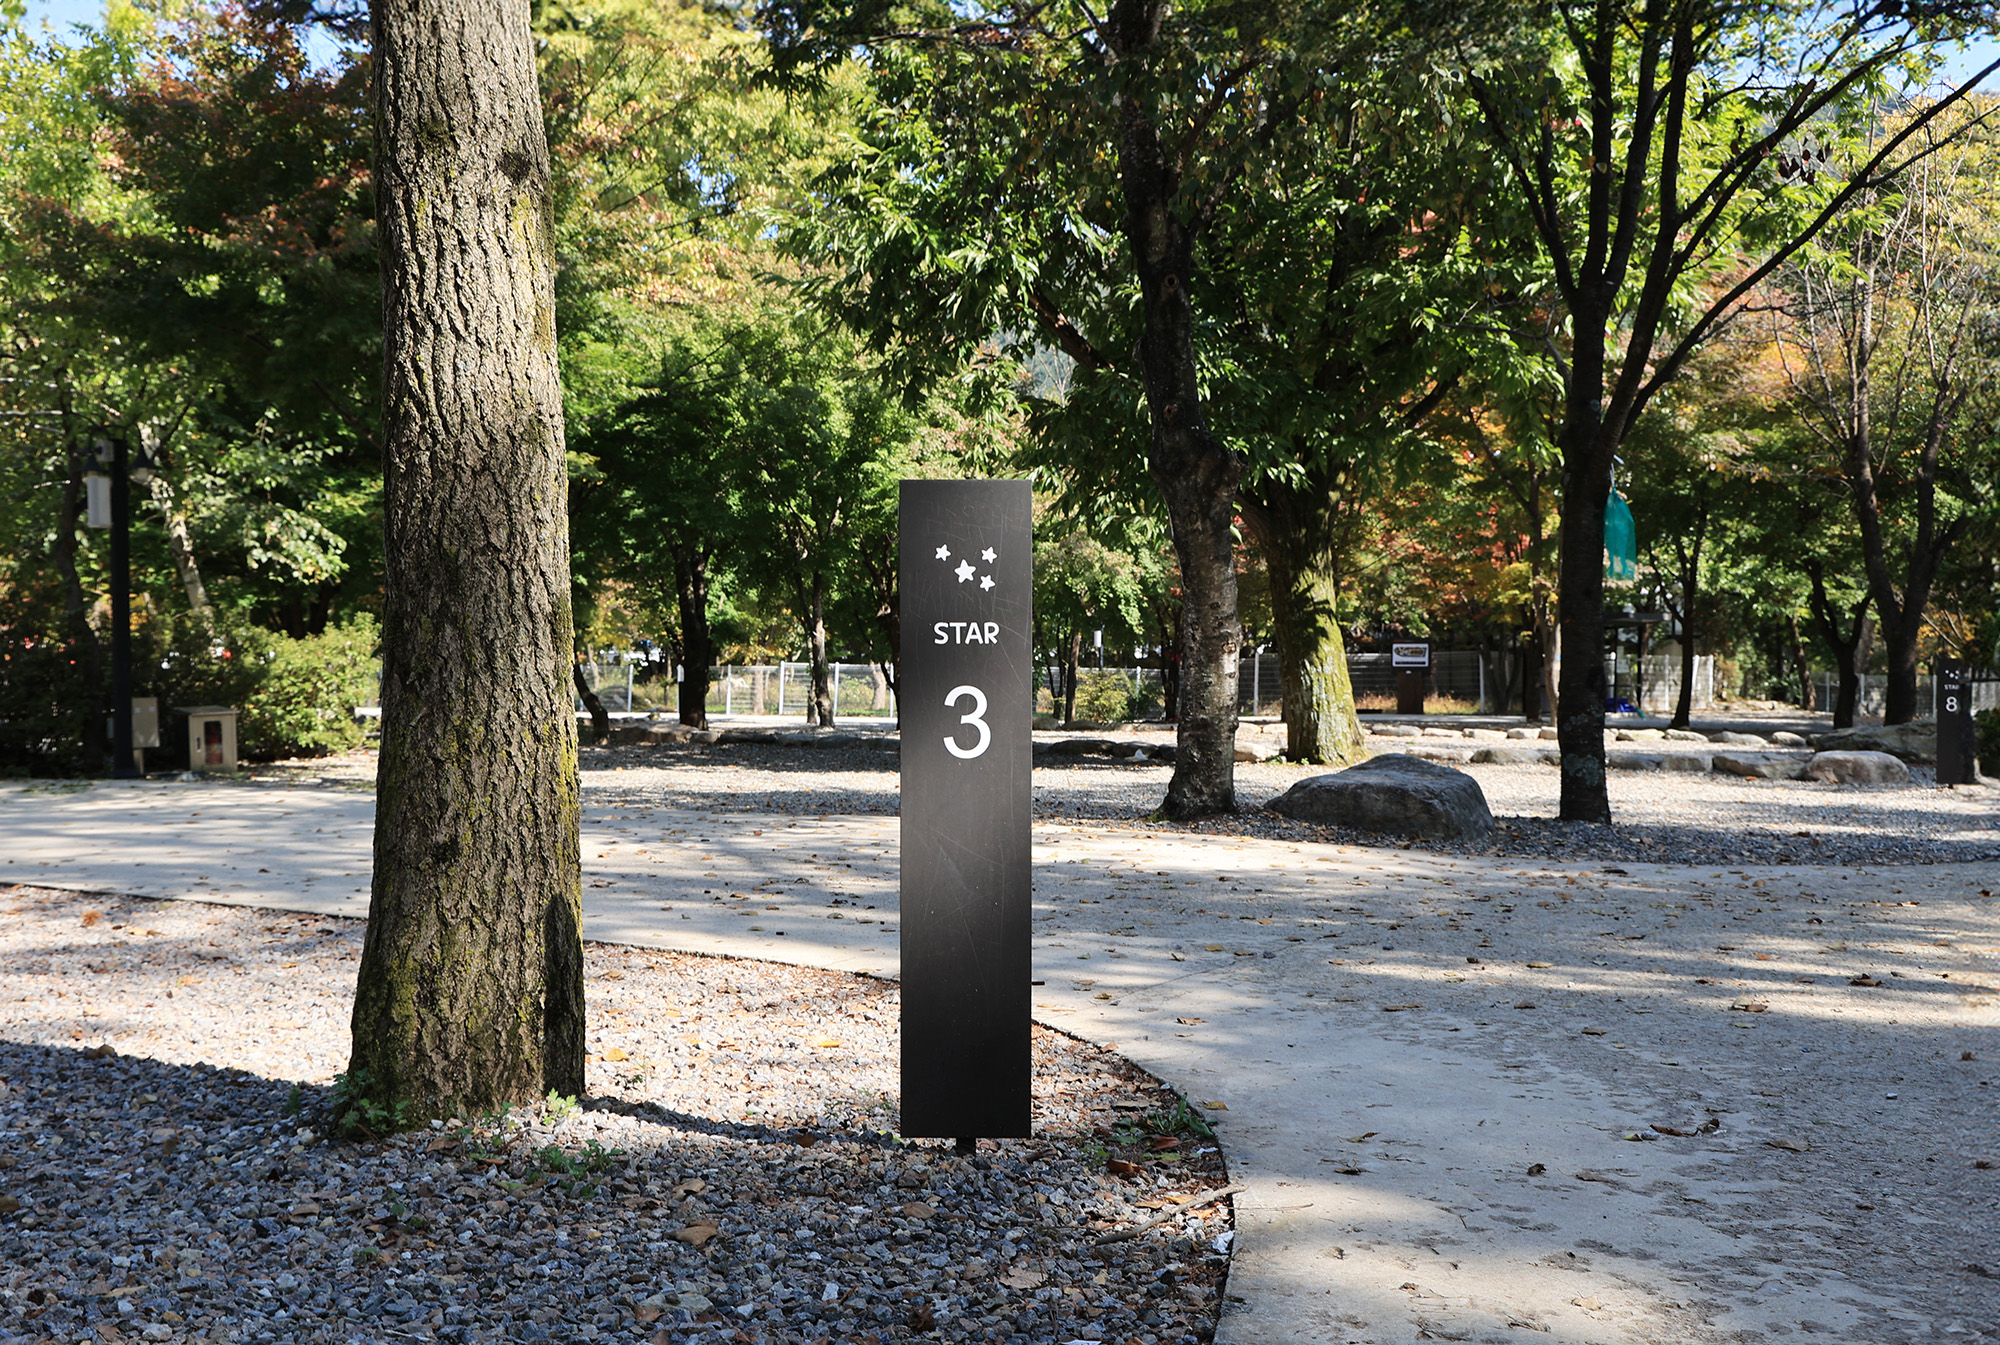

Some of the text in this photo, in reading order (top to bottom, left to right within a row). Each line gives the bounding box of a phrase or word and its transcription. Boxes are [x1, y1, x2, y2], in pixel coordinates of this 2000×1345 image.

[933, 621, 1000, 645] STAR
[1945, 696, 1958, 712] 8
[943, 685, 992, 759] 3
